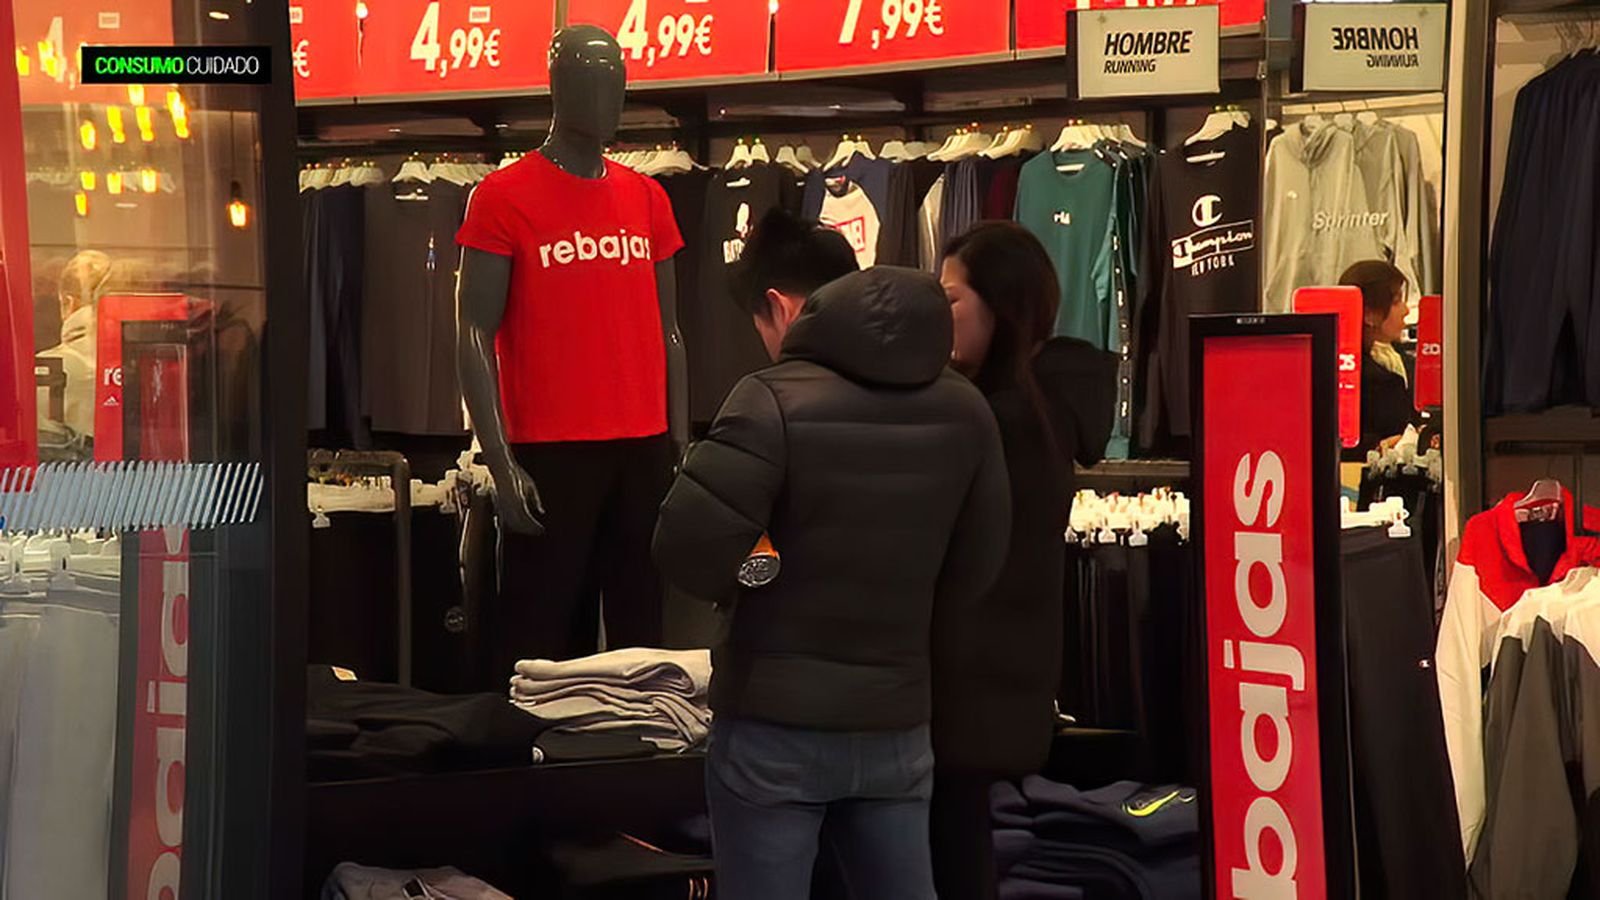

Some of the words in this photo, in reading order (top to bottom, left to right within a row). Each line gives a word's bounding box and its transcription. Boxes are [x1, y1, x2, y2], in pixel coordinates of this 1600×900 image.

[410, 1, 501, 78] 4,99€
[616, 0, 714, 67] 4,99€
[1104, 30, 1193, 57] HOMBRE
[1103, 58, 1156, 75] RUNNING
[1312, 211, 1389, 232] Sprinter
